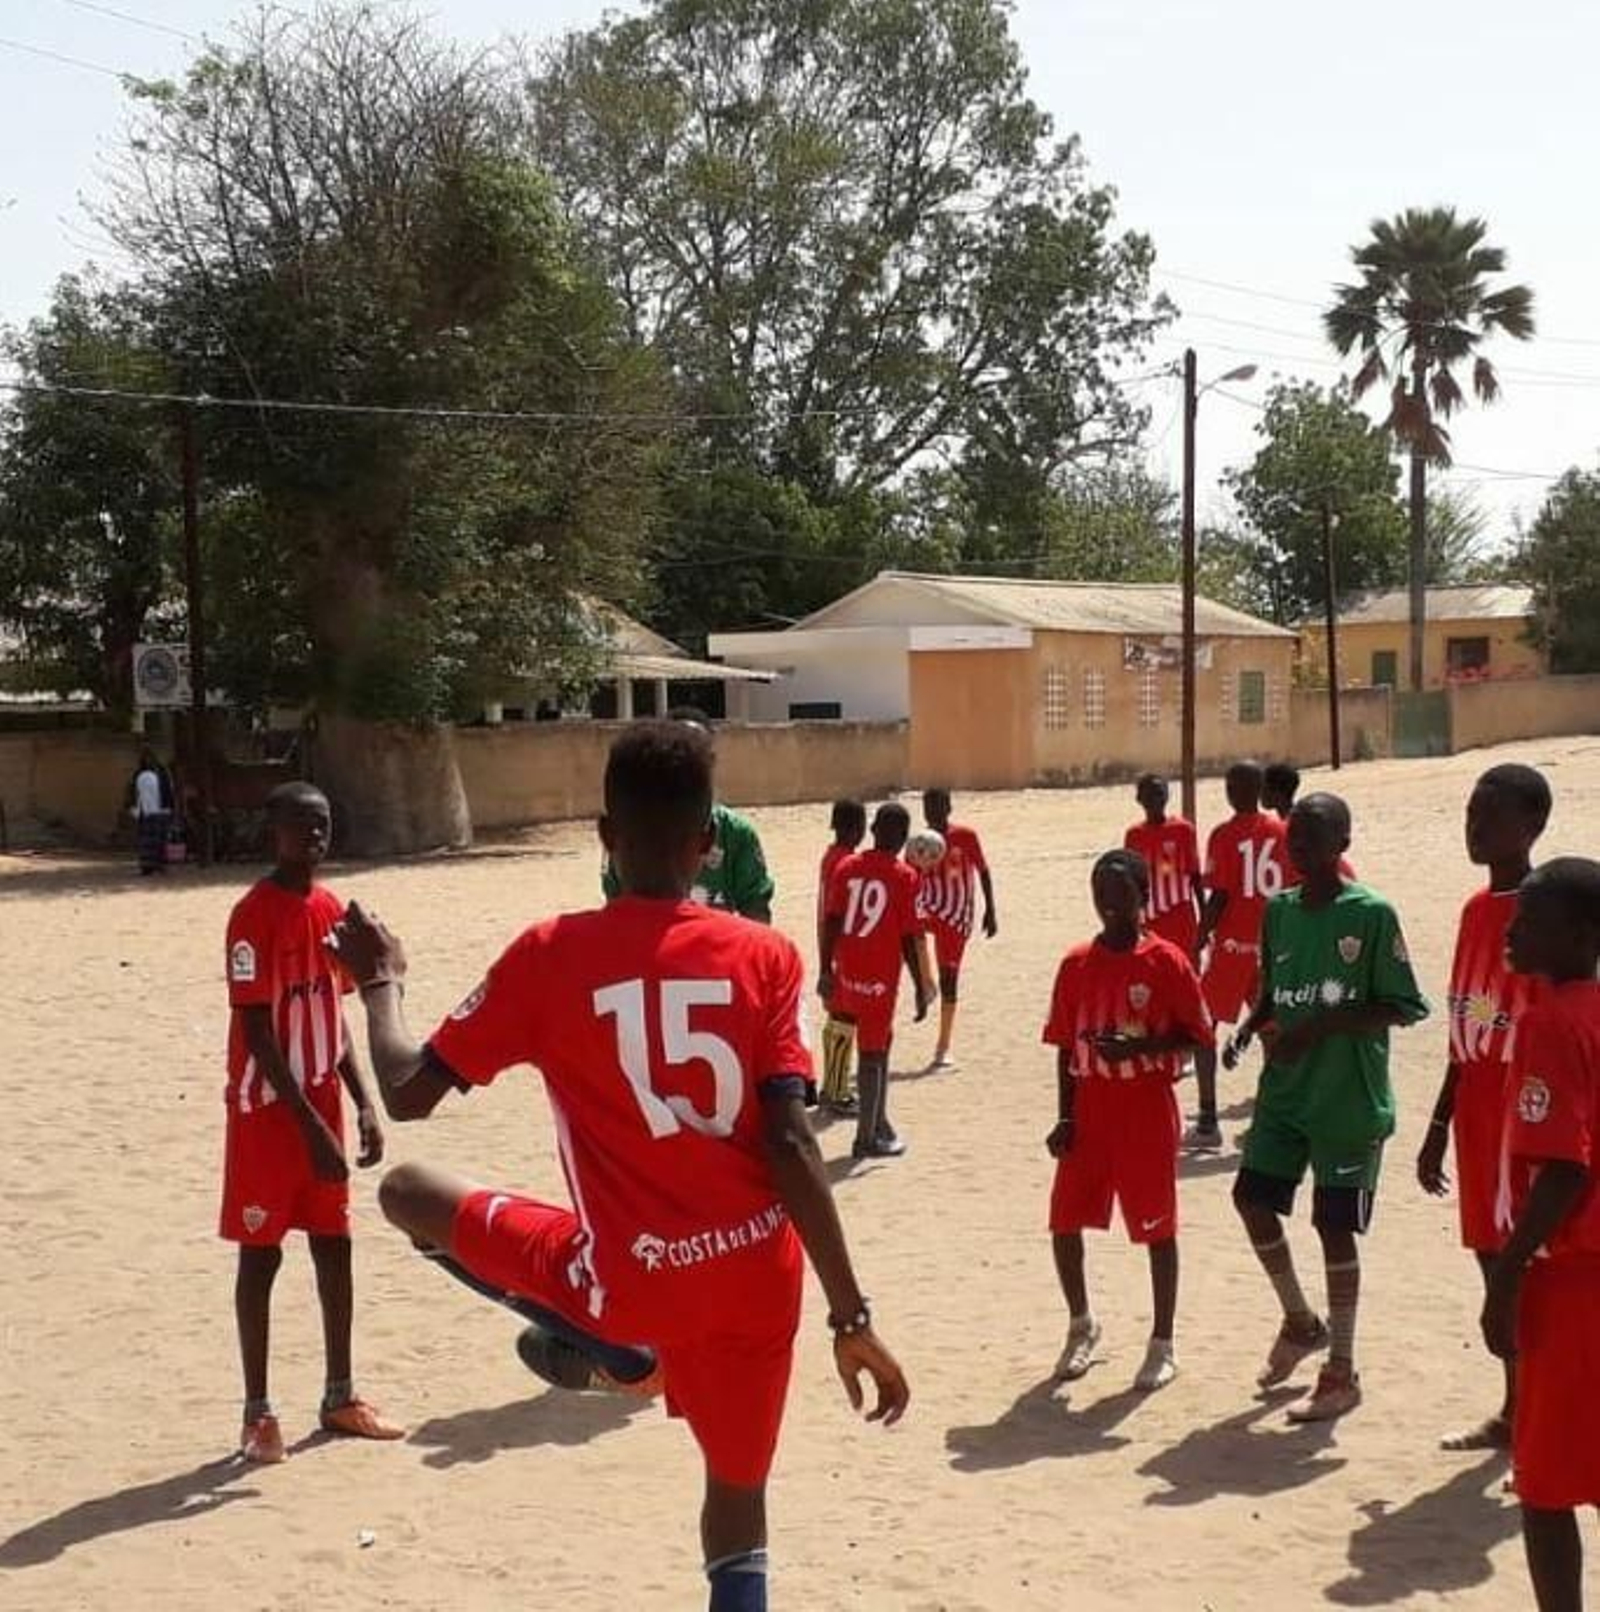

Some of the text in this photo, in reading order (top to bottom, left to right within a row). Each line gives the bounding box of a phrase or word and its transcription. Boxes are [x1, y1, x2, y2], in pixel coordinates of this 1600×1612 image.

[1237, 838, 1284, 898] 16
[843, 878, 889, 938] 19
[593, 978, 743, 1139] 15
[667, 1228, 729, 1268] COSTA
[729, 1226, 748, 1250] DE
